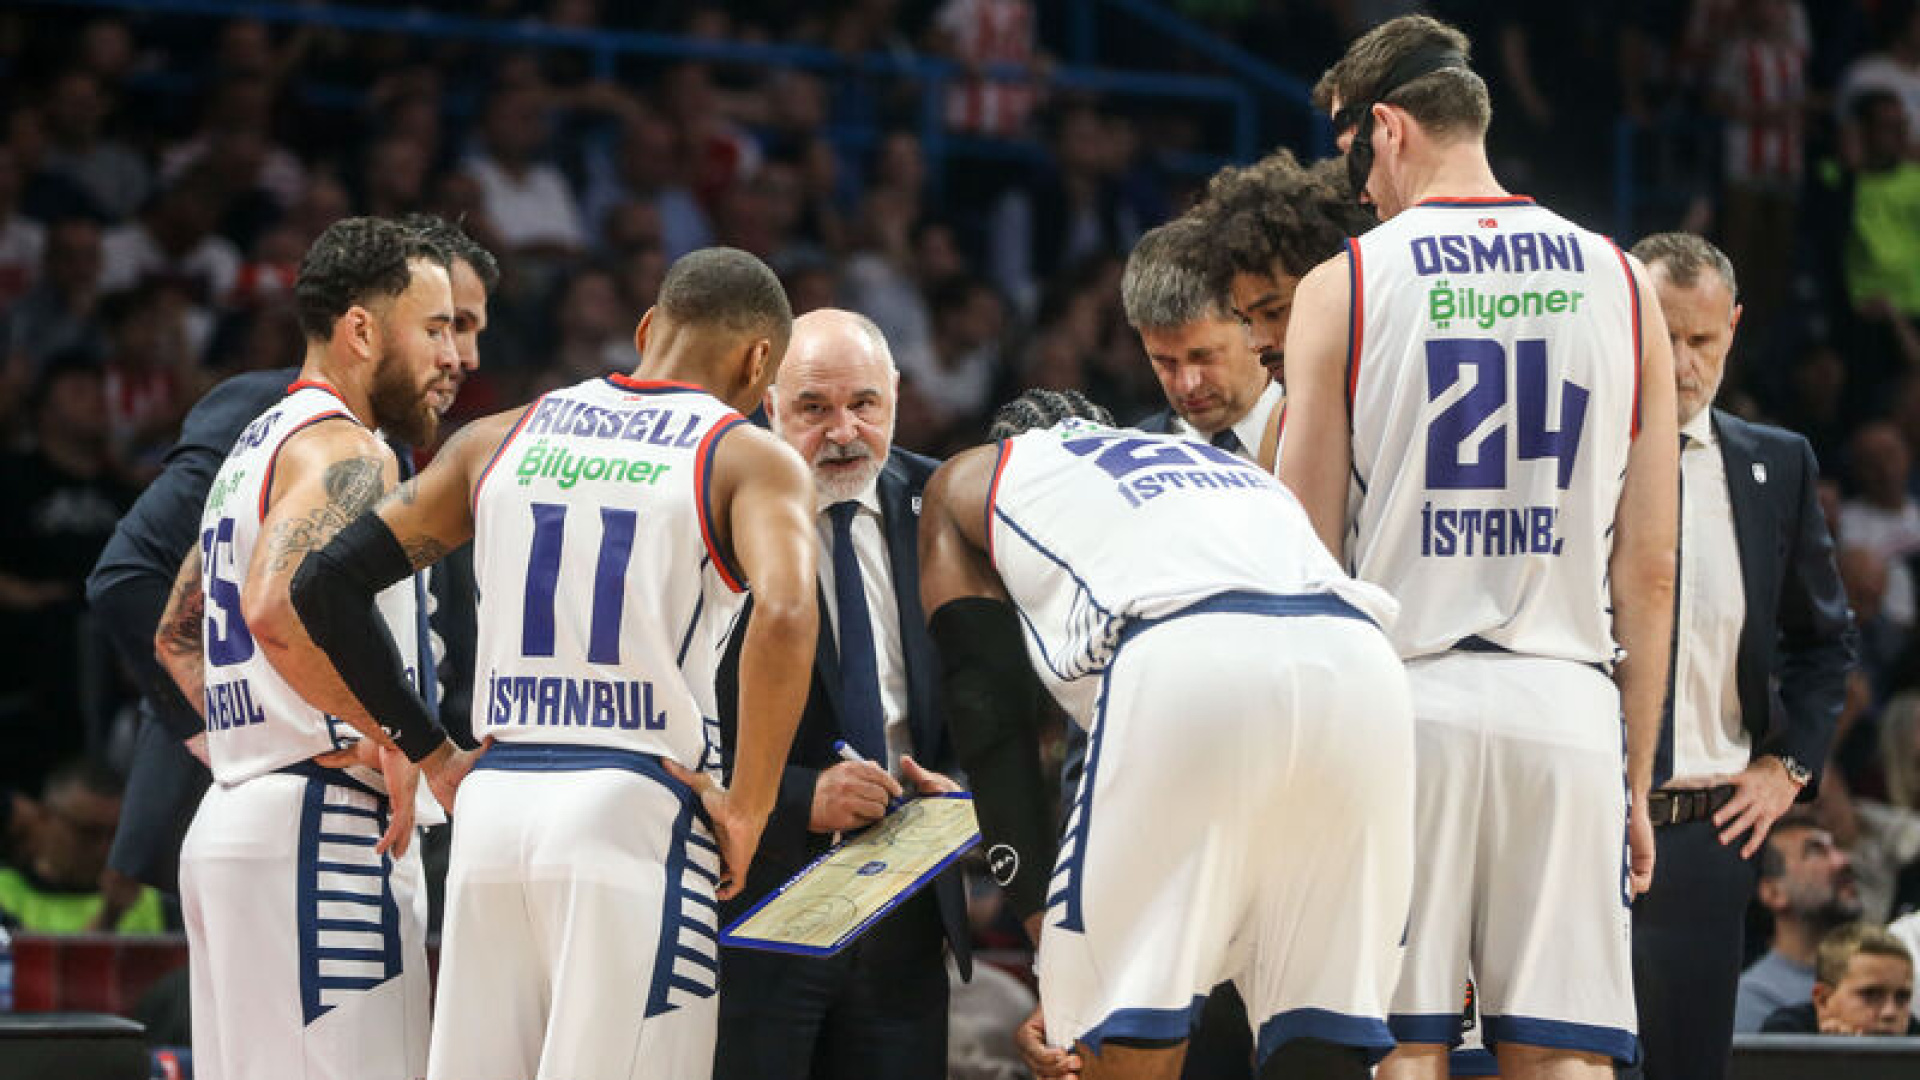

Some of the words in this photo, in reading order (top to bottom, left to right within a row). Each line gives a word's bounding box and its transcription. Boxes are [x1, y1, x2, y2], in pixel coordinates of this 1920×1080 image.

[1429, 280, 1585, 330] Bilyoner
[525, 397, 702, 448] RUSSELL
[1425, 338, 1591, 491] 24
[516, 438, 672, 490] Bilyoner
[521, 503, 637, 665] 11
